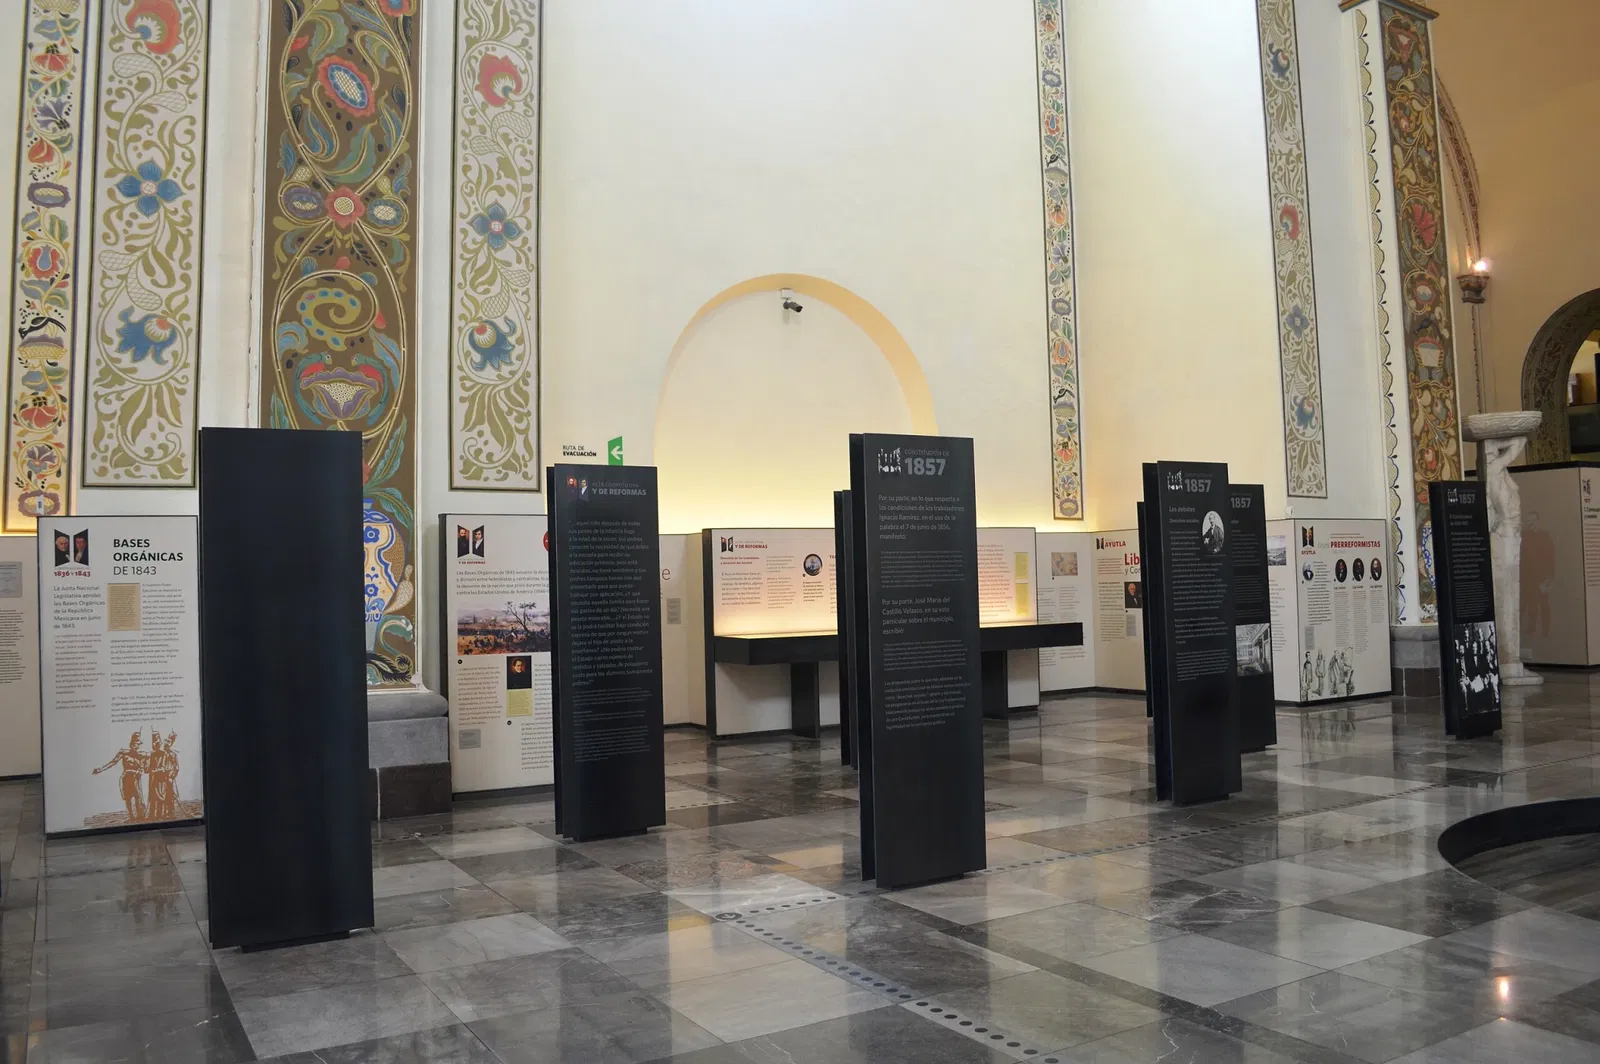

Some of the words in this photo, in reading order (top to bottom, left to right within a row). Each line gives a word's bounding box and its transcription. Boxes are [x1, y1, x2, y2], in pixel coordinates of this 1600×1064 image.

[905, 457, 946, 476] 1857
[1185, 479, 1211, 492] 1857
[1231, 497, 1251, 508] 1857
[1459, 494, 1475, 504] 1857
[113, 539, 150, 548] BASES
[113, 550, 184, 562] ORGÁNICAS
[113, 566, 128, 575] DE
[131, 566, 157, 575] 1843
